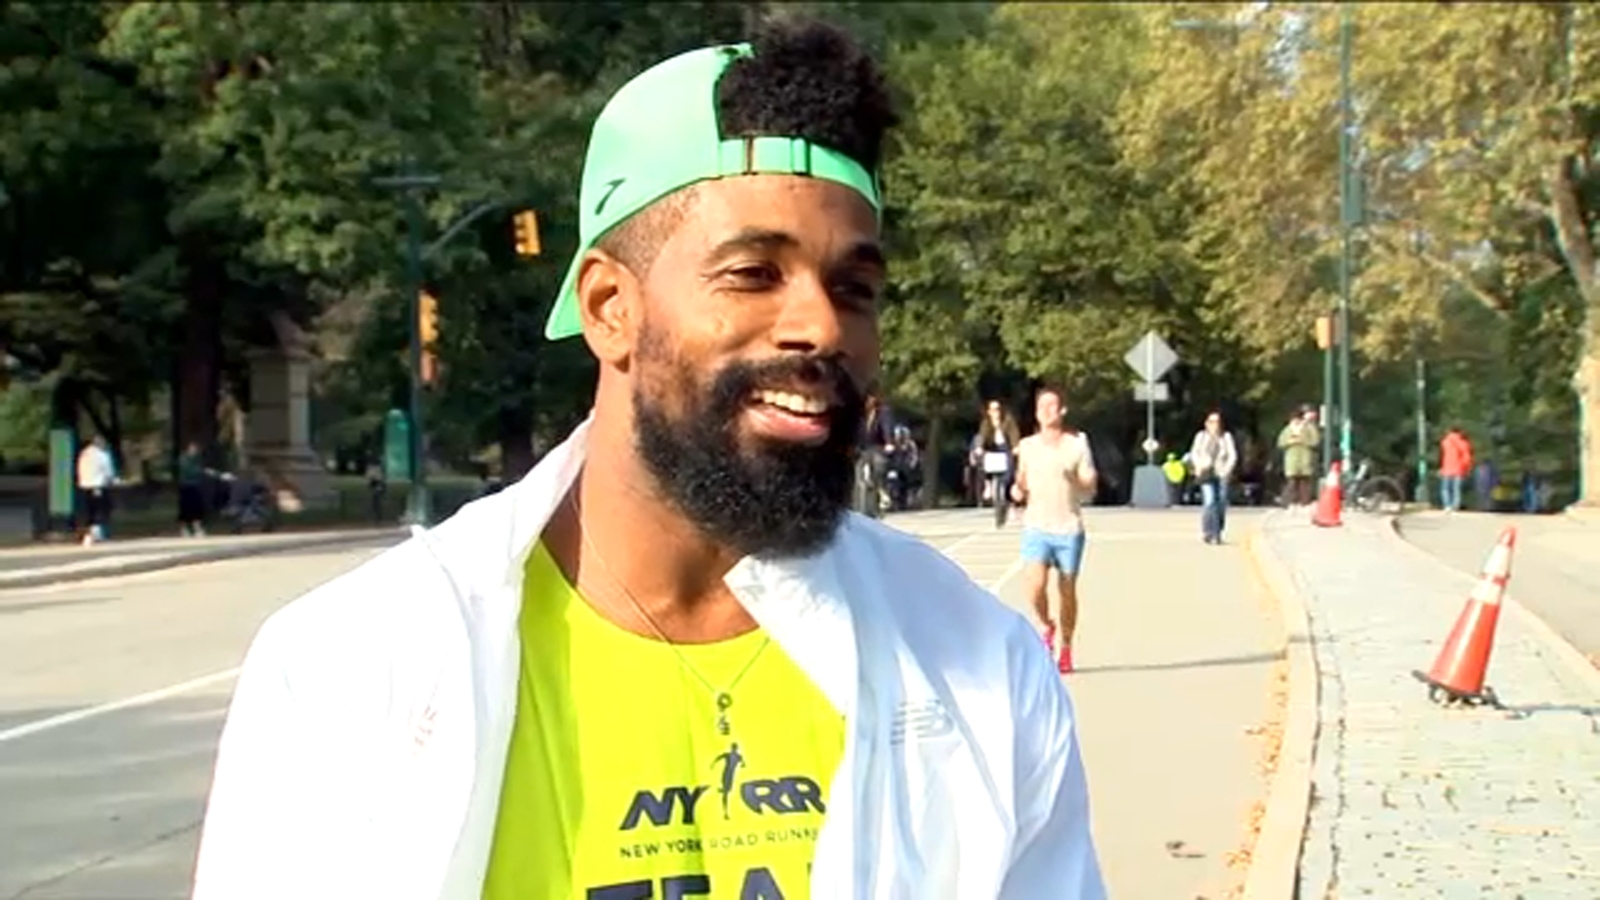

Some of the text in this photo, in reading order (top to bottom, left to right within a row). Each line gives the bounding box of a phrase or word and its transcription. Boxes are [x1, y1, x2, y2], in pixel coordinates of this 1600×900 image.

[619, 843, 661, 858] NEW
[666, 838, 702, 854] YORK
[709, 833, 759, 849] ROAD
